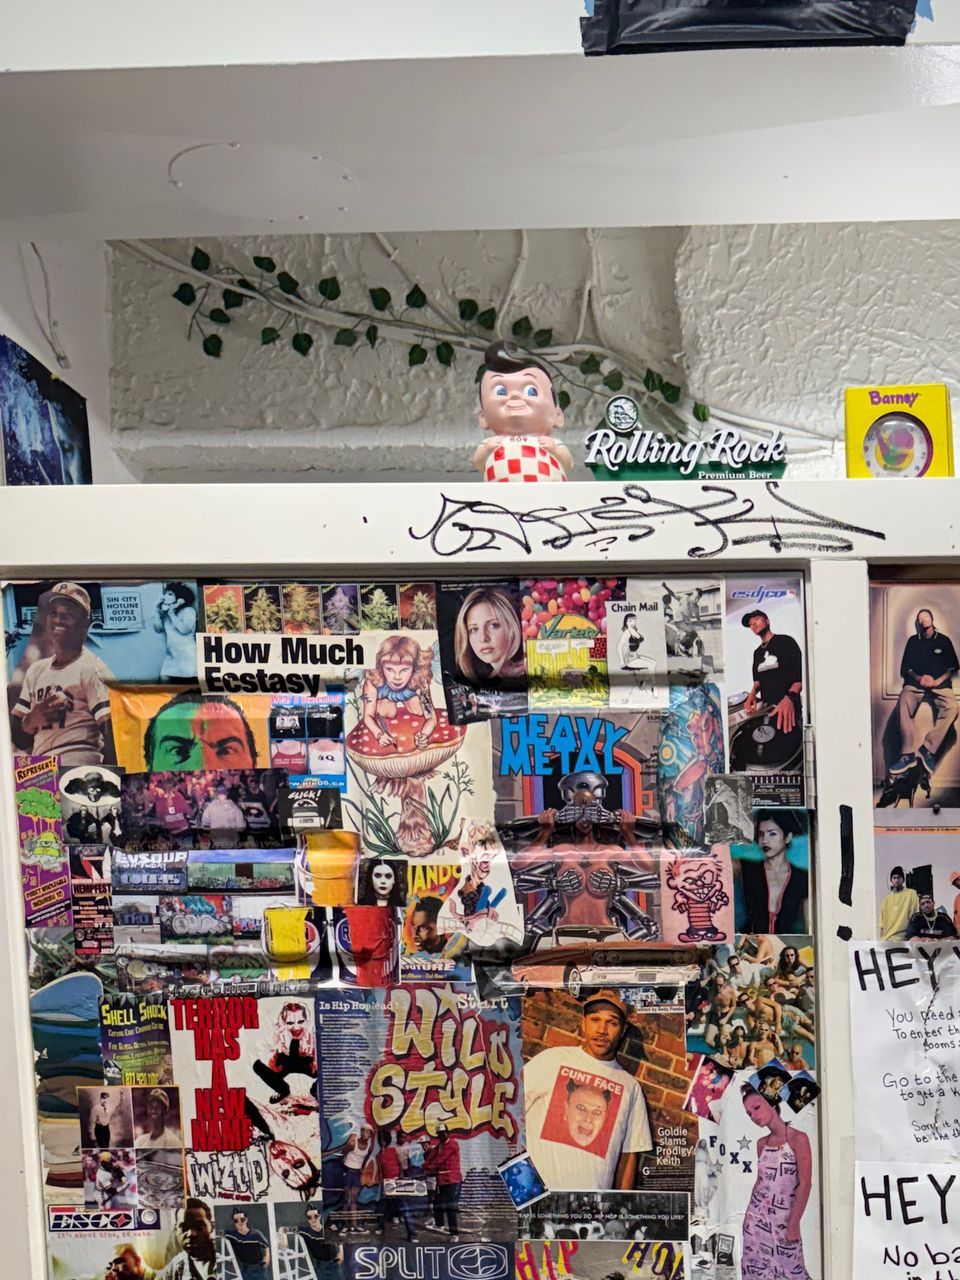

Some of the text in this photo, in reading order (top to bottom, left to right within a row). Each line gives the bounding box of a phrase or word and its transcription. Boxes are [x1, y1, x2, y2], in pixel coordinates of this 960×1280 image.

[869, 391, 918, 408] Barney
[584, 430, 786, 474] Rolling Rock
[698, 471, 773, 479] Premium Beer
[106, 602, 139, 610] HOTLINE
[611, 602, 659, 613] Chain Mail
[203, 636, 365, 665] How Much
[204, 667, 321, 697] Ecstasy
[502, 714, 630, 760] HEAVY
[17, 757, 57, 780] REPRESENT!
[501, 741, 628, 775] METAL
[854, 946, 942, 992] HEY
[320, 1001, 370, 1012] Is Hip Hop
[458, 993, 508, 1010] Start
[102, 1001, 168, 1026] SHELL SHOCK
[170, 997, 259, 1030] TERROR
[886, 1008, 913, 1028] You
[920, 1007, 954, 1025] need
[194, 1028, 240, 1060] HAS
[910, 1027, 943, 1040] enter
[561, 1067, 623, 1095] CUNT FACE
[882, 1073, 910, 1089] Go
[914, 1073, 932, 1085] to
[935, 1070, 958, 1084] the
[195, 1088, 246, 1120] NEW
[900, 1088, 914, 1102] to
[917, 1088, 935, 1106] get
[938, 1089, 946, 1098] a
[191, 1118, 252, 1152] NAME
[657, 1126, 688, 1138] Goldie
[943, 1119, 951, 1129] it
[659, 1137, 687, 1147] slams
[914, 1131, 929, 1144] be
[656, 1156, 681, 1166] Keith
[861, 1173, 956, 1225] HEY
[355, 1246, 445, 1279] SPLIT
[883, 1245, 918, 1267] No
